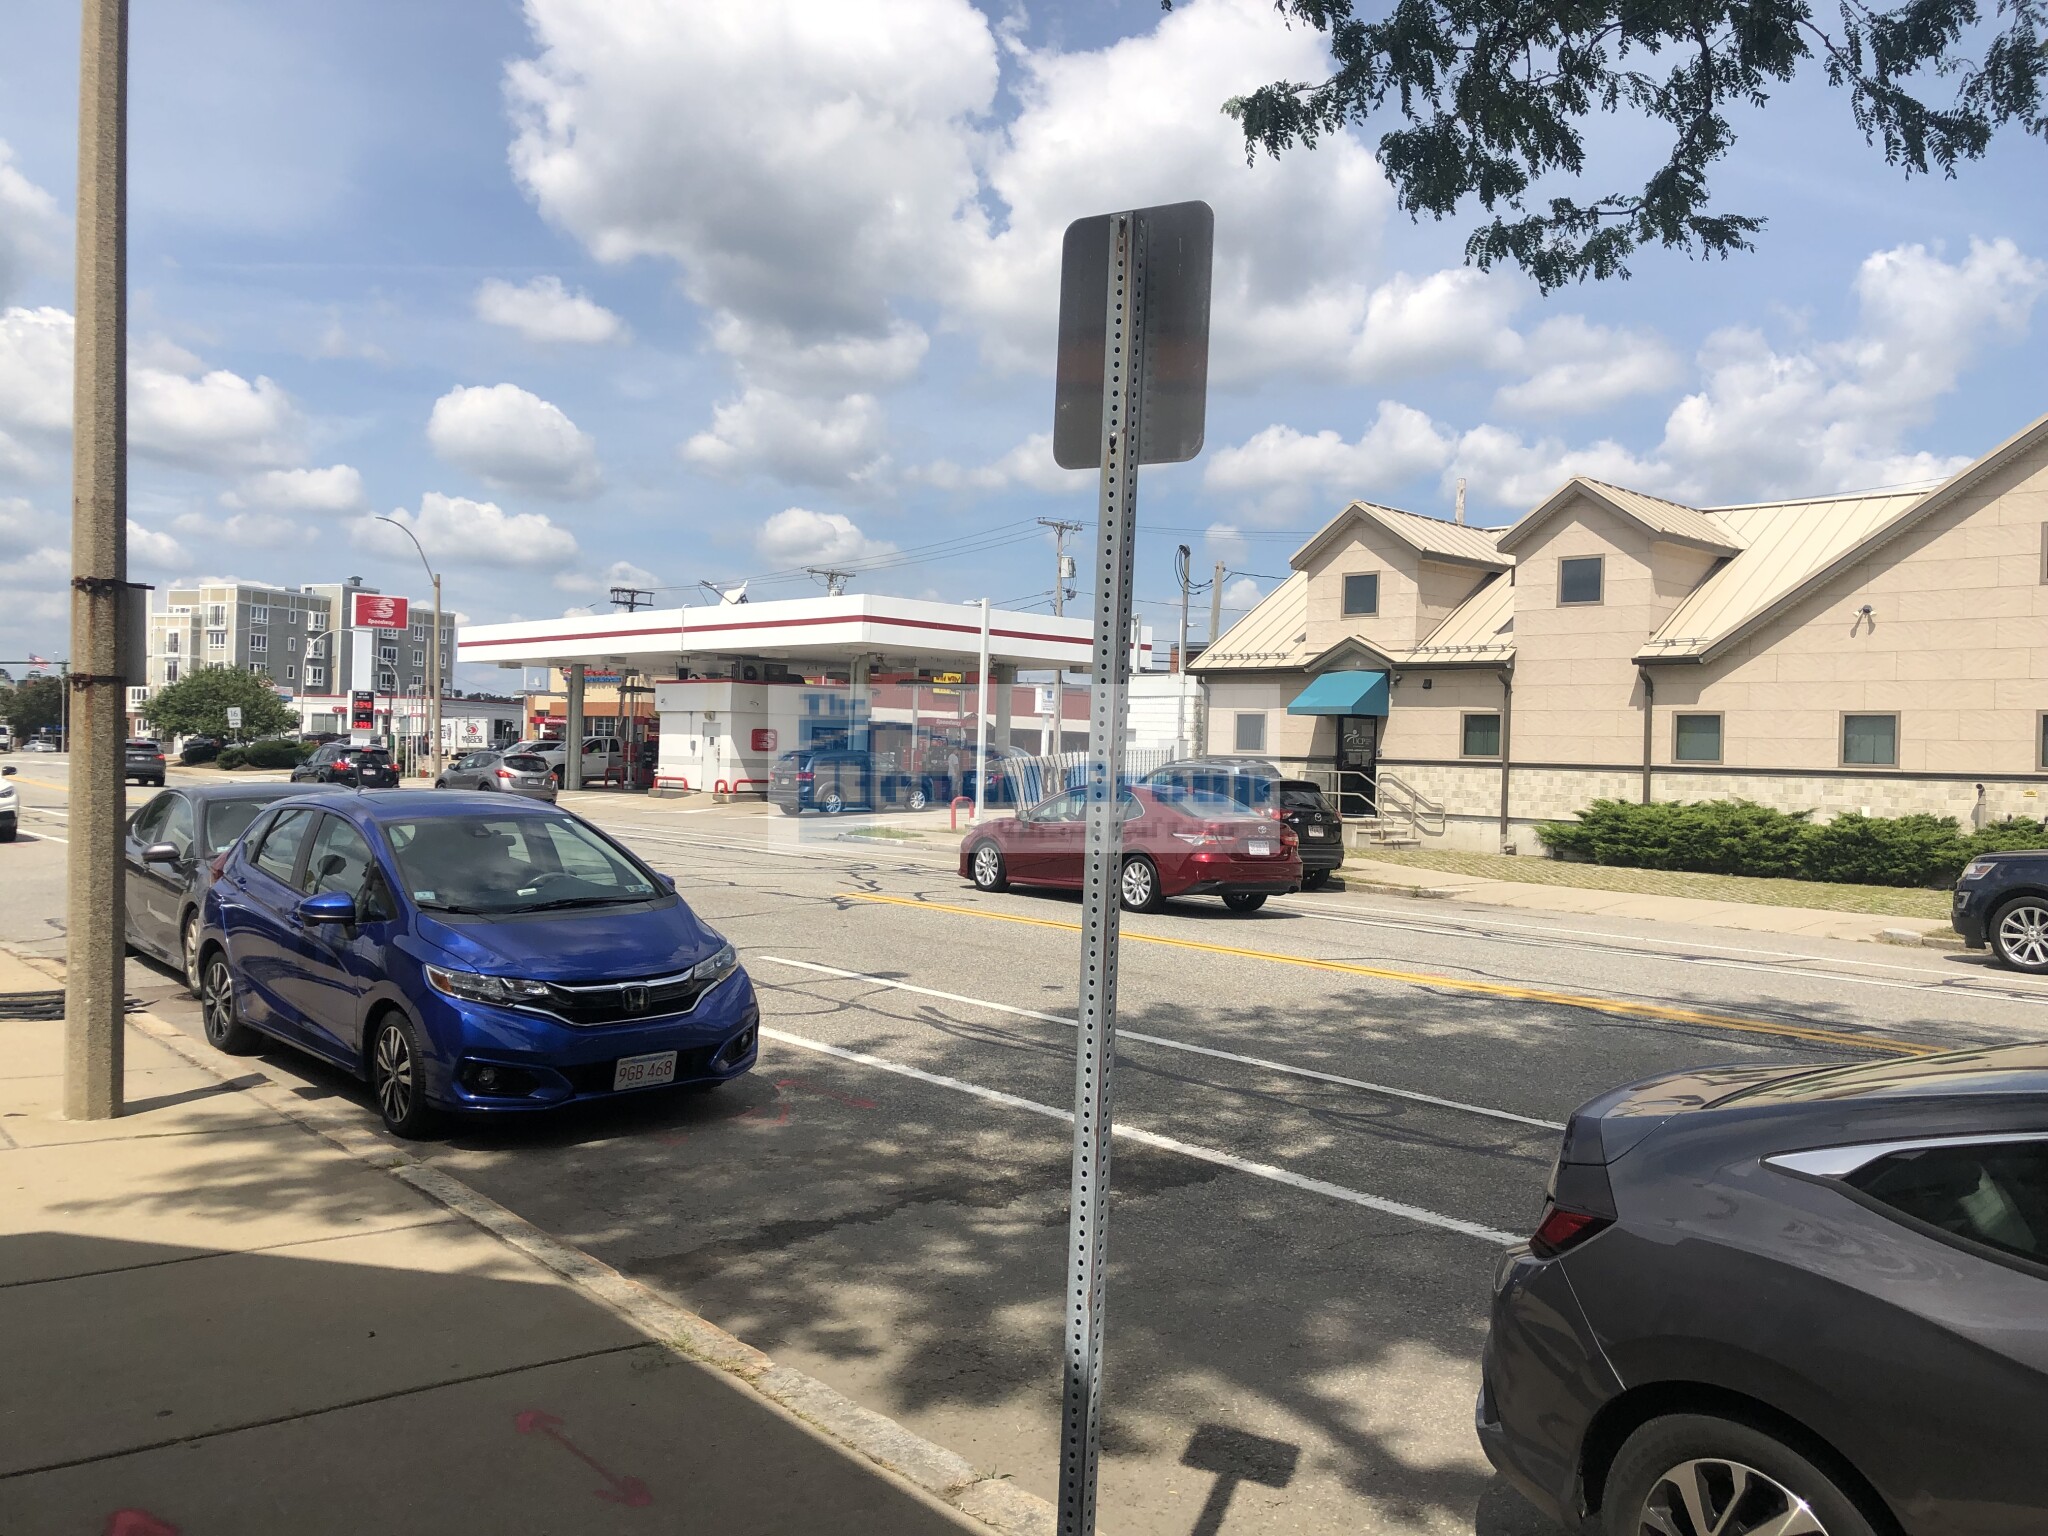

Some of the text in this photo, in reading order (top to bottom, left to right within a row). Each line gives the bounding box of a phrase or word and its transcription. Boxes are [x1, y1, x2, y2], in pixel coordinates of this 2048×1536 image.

[367, 618, 396, 626] Speedway
[936, 718, 962, 727] Speedway
[619, 1064, 643, 1083] 9GB
[647, 1060, 672, 1077] 468
